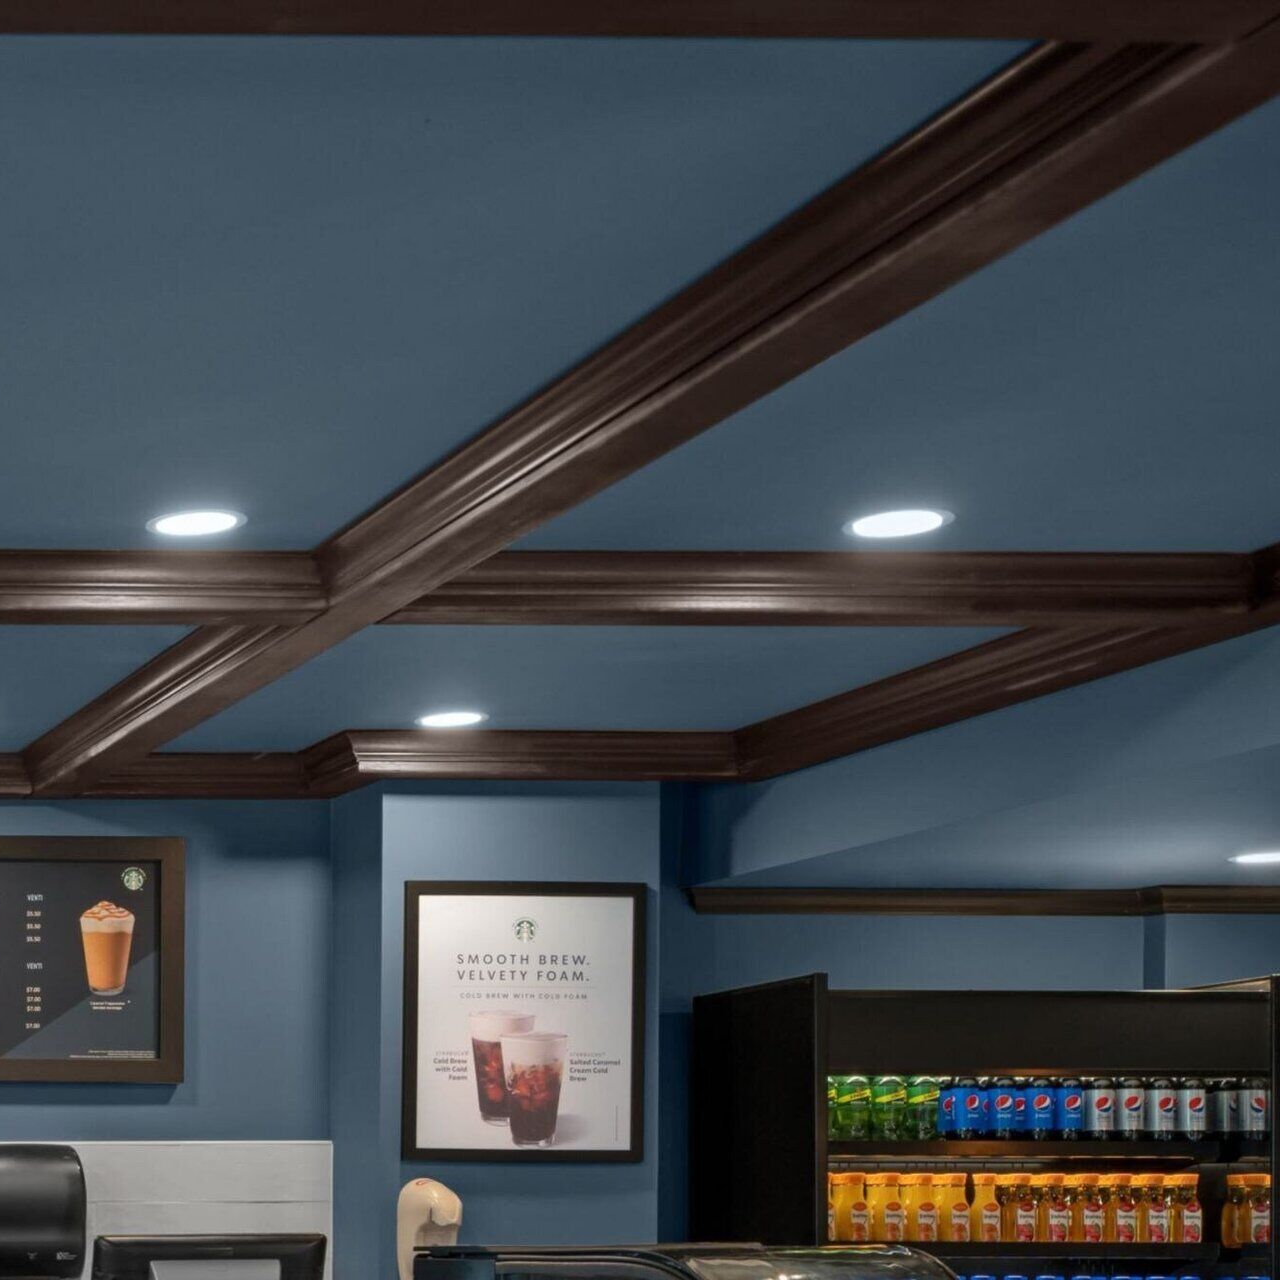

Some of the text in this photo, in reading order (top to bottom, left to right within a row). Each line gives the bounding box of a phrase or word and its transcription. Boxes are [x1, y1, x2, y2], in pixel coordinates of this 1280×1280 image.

[26, 962, 43, 970] VENTI
[457, 954, 590, 967] SMOOTH BREW.
[457, 970, 590, 982] VELVETY FOAM.
